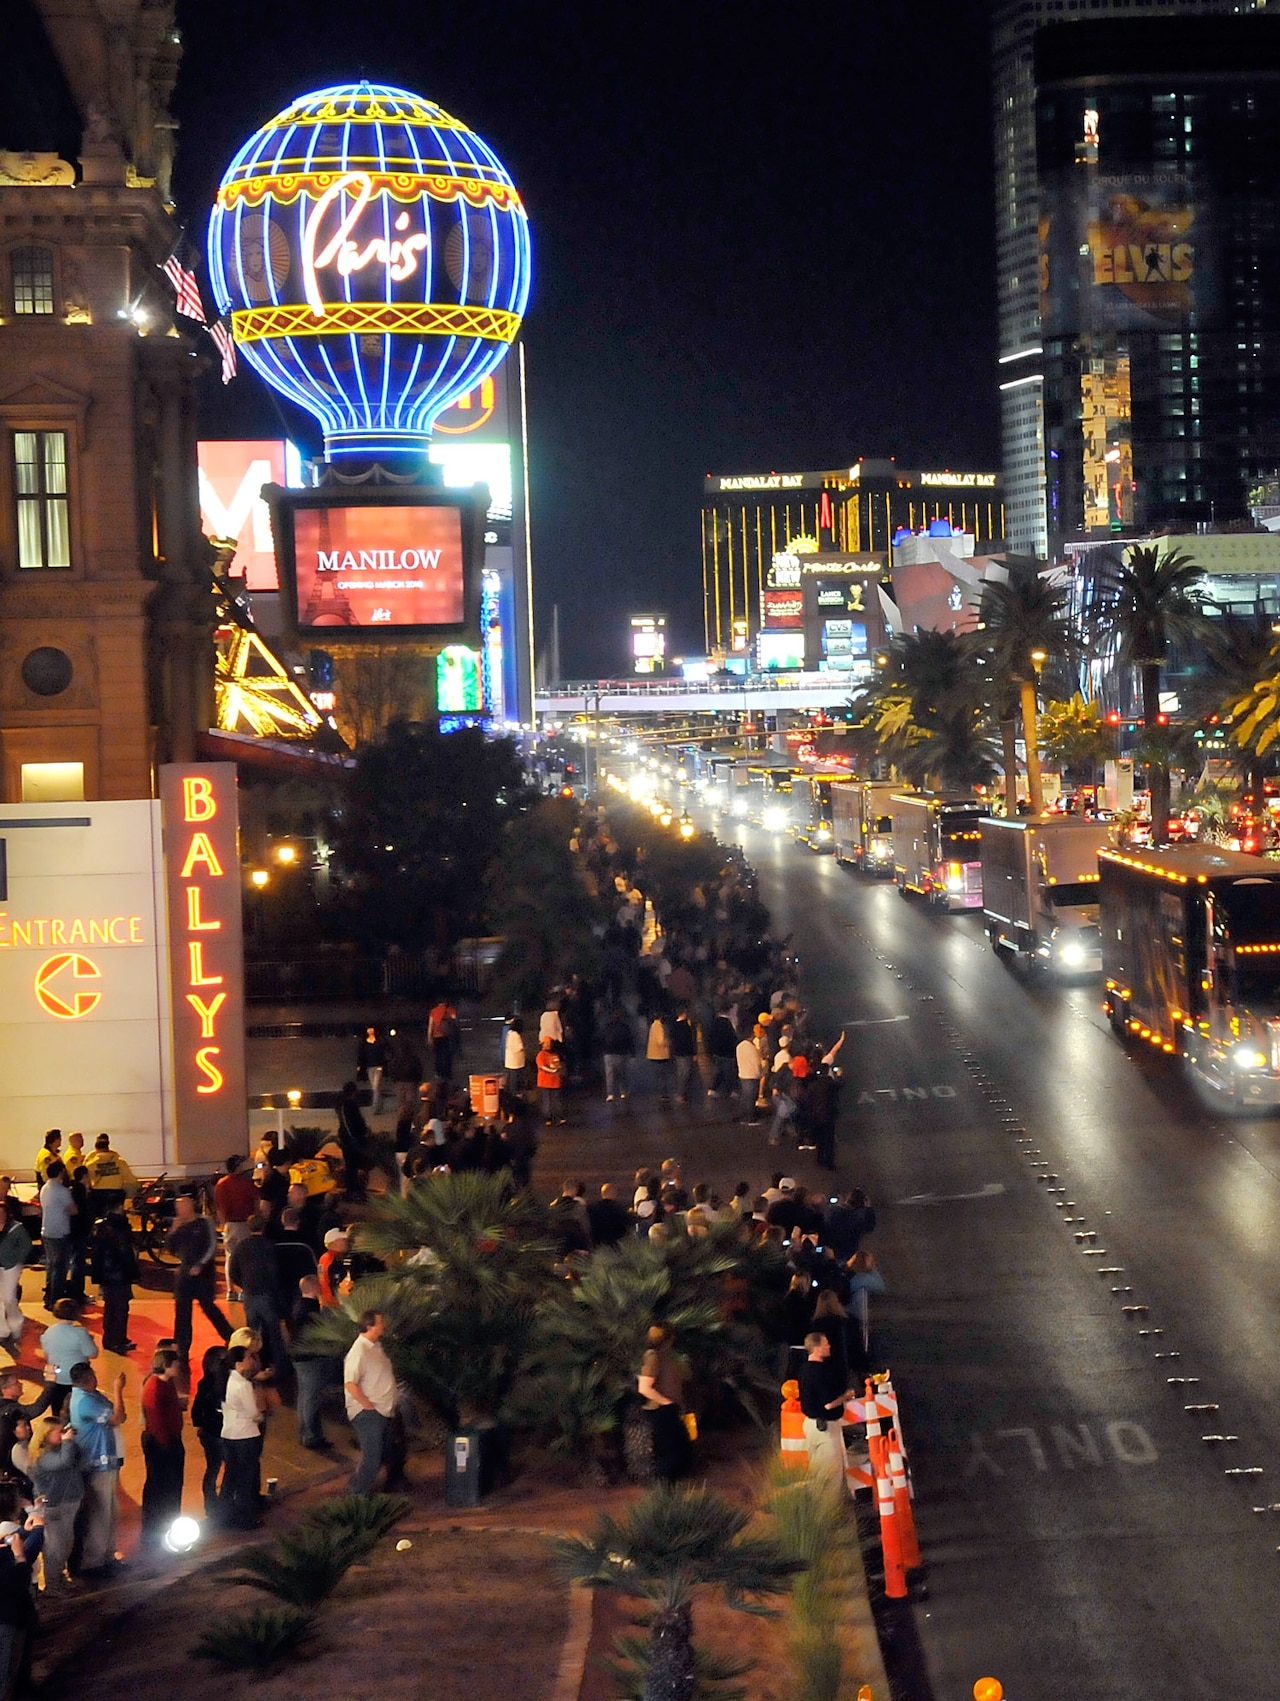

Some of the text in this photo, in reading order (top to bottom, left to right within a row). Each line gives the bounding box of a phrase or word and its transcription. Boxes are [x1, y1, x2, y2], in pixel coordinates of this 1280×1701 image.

[1092, 173, 1190, 186] CIRQUE DU SOLEIL
[303, 171, 428, 316] Paris
[1093, 243, 1195, 284] ELVIS
[719, 475, 803, 491] MANDALAY BAY
[921, 473, 996, 487] MANDALAY BAY
[316, 549, 442, 571] MANILOW
[180, 776, 227, 1095] BALLYS
[858, 1086, 957, 1105] ONLY
[966, 1420, 1161, 1478] ONLY
